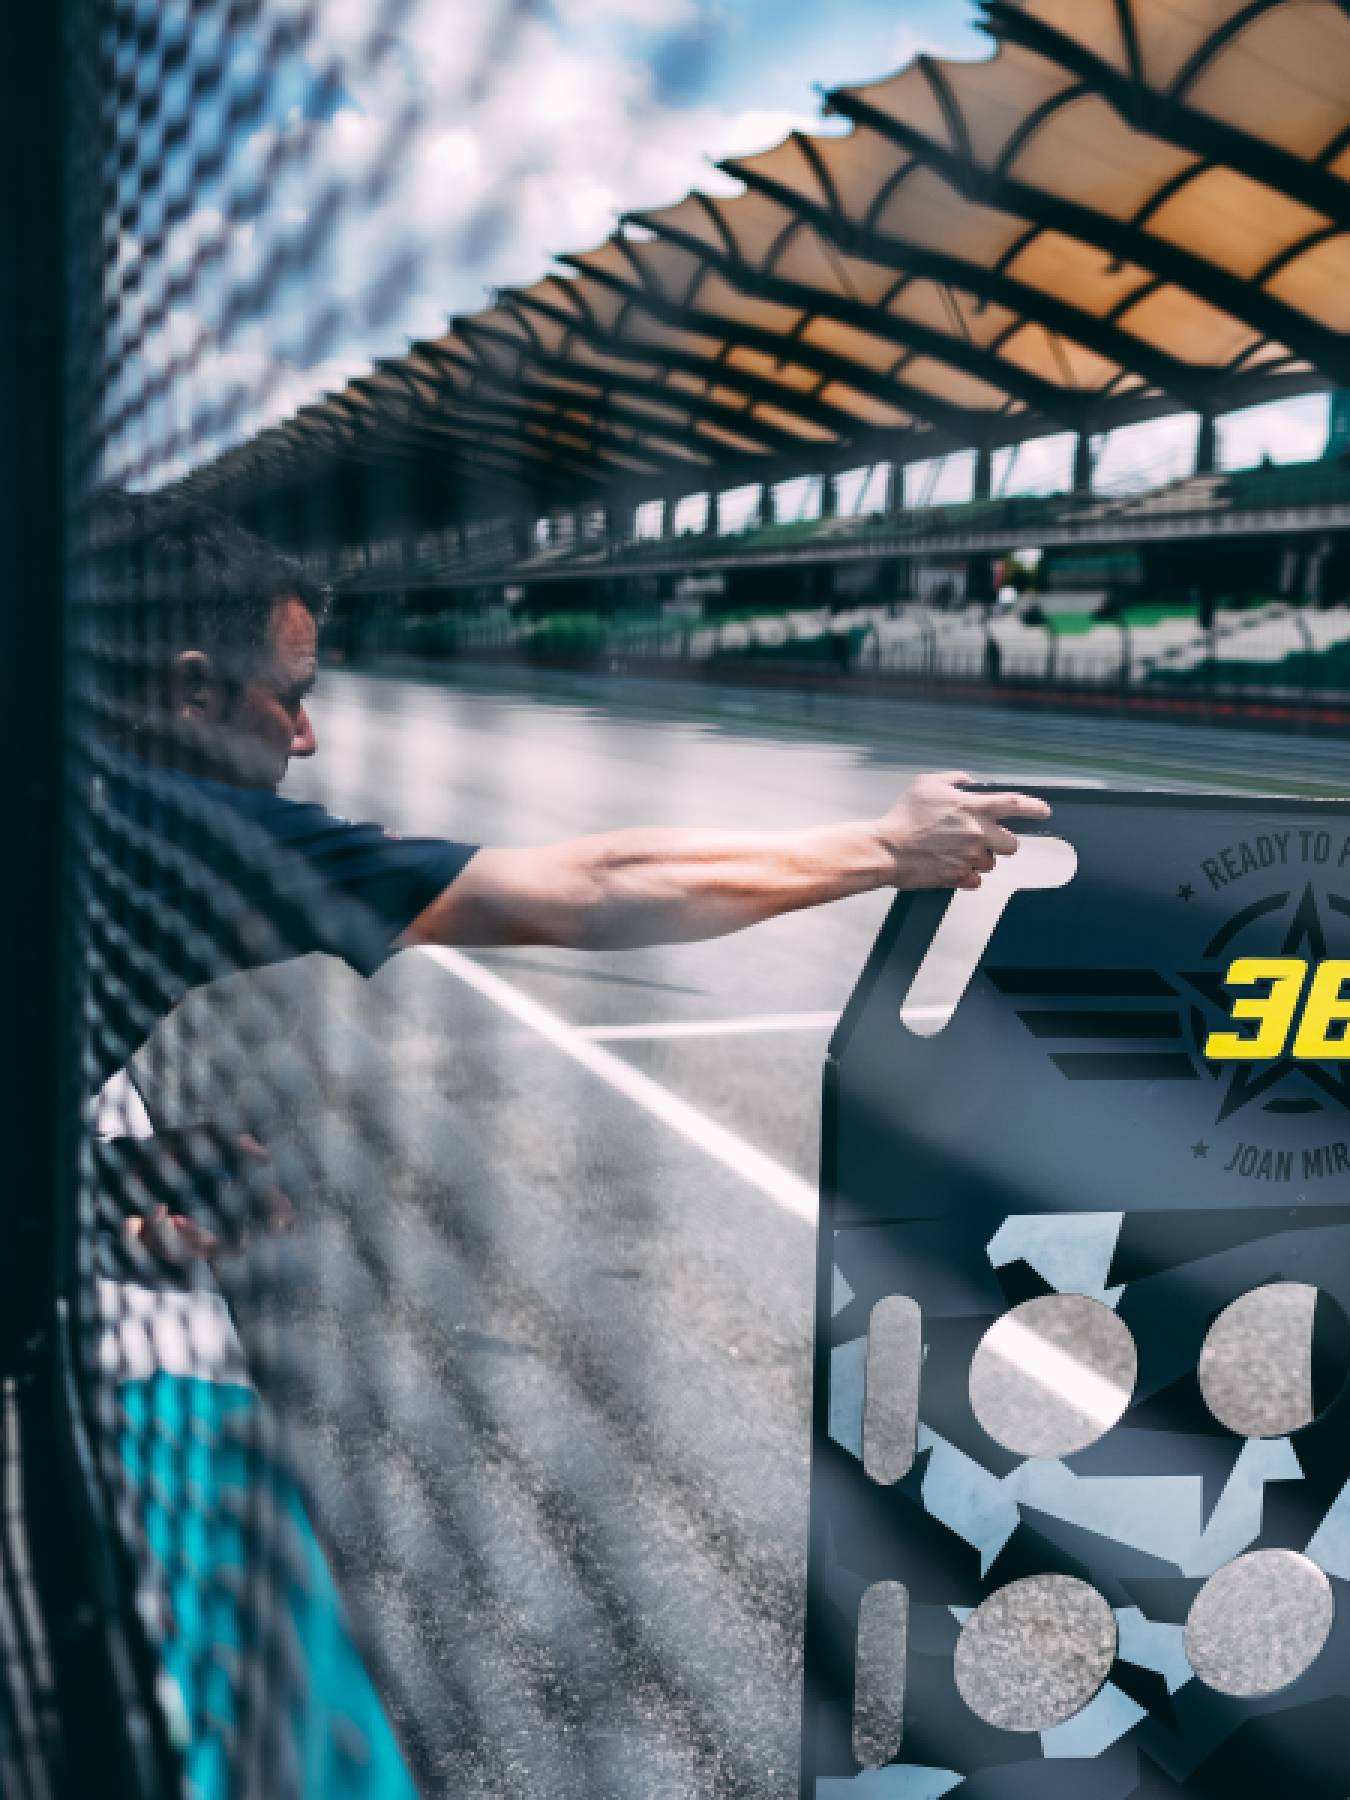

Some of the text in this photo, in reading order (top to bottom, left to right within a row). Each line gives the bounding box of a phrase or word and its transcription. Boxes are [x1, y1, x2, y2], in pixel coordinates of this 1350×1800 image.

[1201, 831, 1290, 889] READY
[1299, 830, 1331, 864] TO
[1223, 1142, 1294, 1182] JOAN
